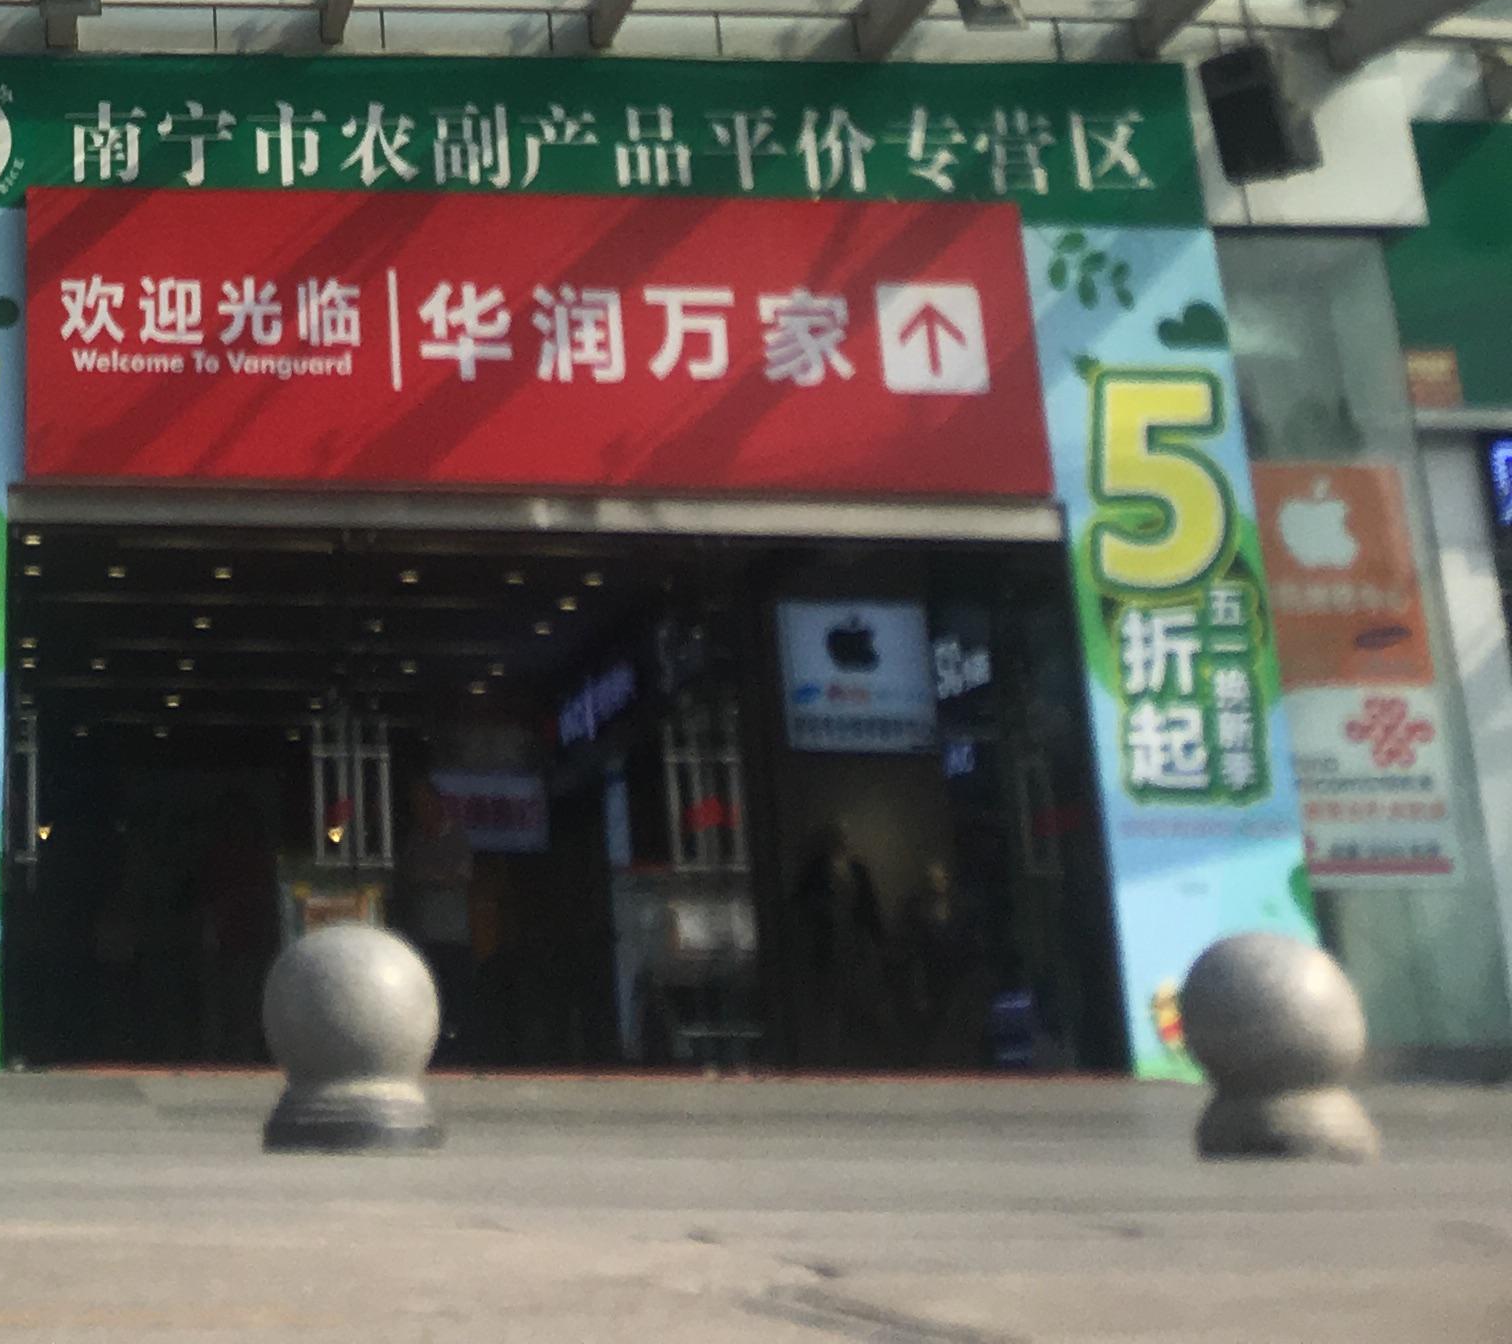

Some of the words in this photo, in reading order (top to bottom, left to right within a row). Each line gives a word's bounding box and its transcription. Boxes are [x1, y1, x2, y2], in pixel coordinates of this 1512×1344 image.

[66, 99, 1156, 194] 南宁市农副产品平价专营区
[60, 273, 362, 348] 欢迎光临
[418, 280, 855, 387] 华润万家
[72, 348, 185, 374] Welcome
[191, 350, 220, 375] To
[226, 350, 354, 381] Vanguard
[1095, 373, 1231, 595] 5
[1120, 604, 1210, 790] 折起
